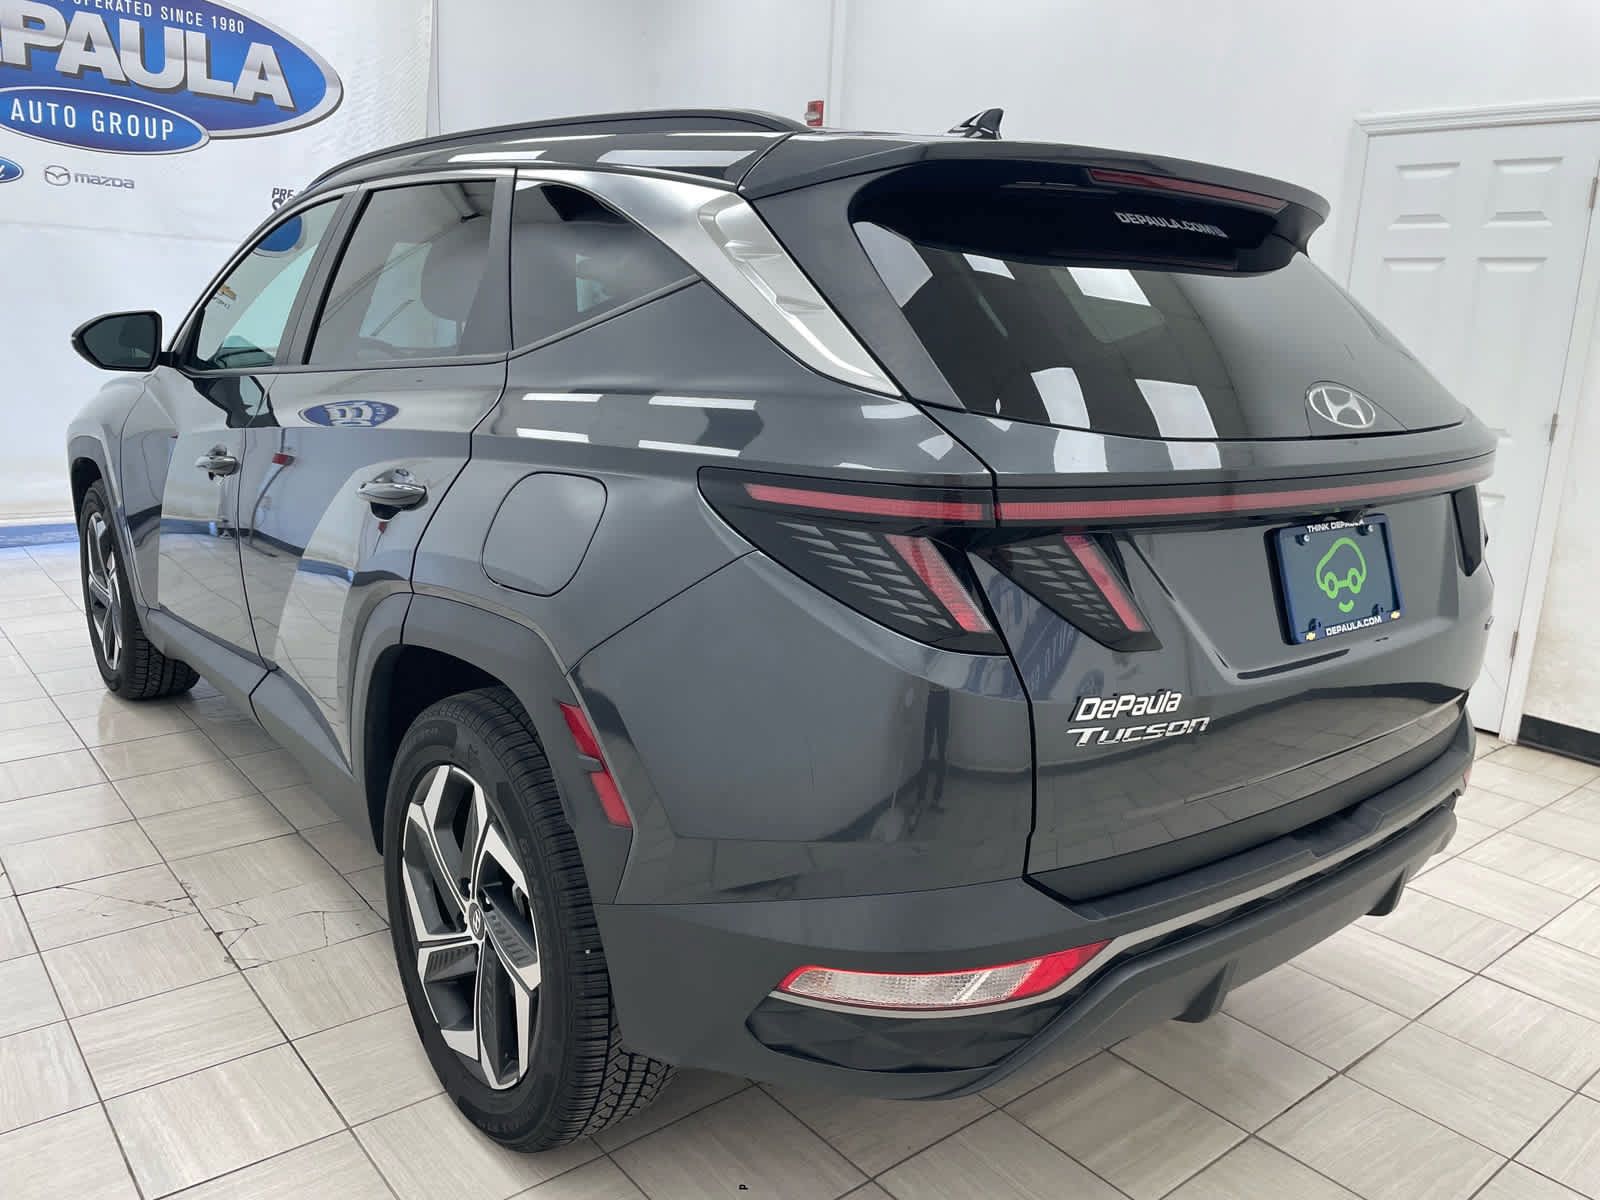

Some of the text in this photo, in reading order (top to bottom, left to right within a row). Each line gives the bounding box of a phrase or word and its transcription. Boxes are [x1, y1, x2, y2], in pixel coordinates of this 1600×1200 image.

[161, 6, 203, 27] SINCE
[211, 16, 244, 34] 1980
[0, 0, 296, 109] PAULA
[10, 98, 174, 141] AUTO GROUP
[74, 173, 135, 189] mazda
[1306, 523, 1330, 533] THINK
[1325, 616, 1383, 636] DEPAULA.COM
[1075, 690, 1182, 721] DePaula
